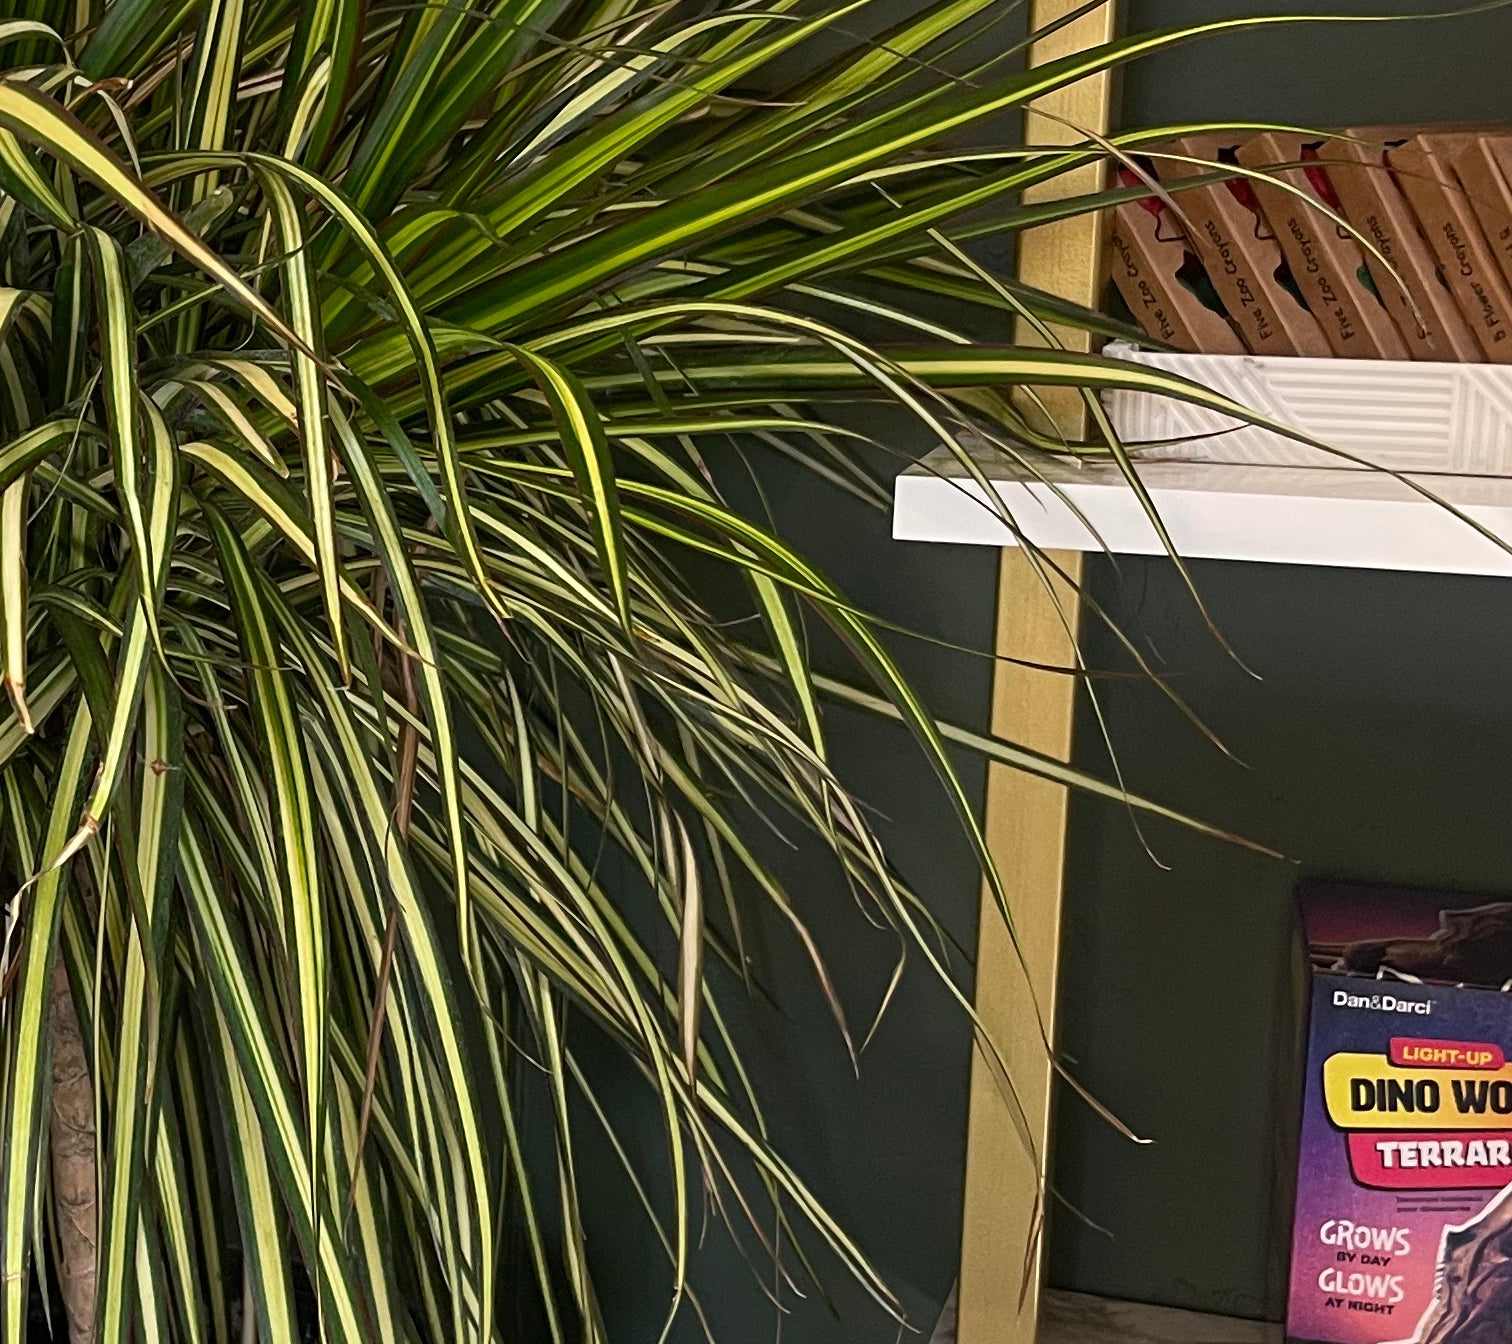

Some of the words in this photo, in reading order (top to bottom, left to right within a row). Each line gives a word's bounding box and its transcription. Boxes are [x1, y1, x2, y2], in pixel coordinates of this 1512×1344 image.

[1204, 219, 1237, 274] Crayons
[1288, 218, 1319, 273] Crayons
[1443, 222, 1473, 276] Crayons
[1138, 280, 1157, 309] Zoo
[1236, 278, 1255, 307] Zoo
[1318, 277, 1337, 306] Zoo
[1471, 282, 1500, 328] Flower
[1155, 308, 1175, 340] Five
[1252, 308, 1273, 341] Five
[1335, 308, 1356, 341] Five
[1333, 991, 1432, 1015] Dan&Darci
[1402, 1046, 1493, 1065] LIGHT-UP
[1350, 1078, 1440, 1113] DINO
[1320, 1219, 1411, 1256] GROWS
[1337, 1251, 1357, 1262] BY
[1361, 1255, 1391, 1267] DAY
[1319, 1268, 1404, 1303] GLOWS
[1325, 1298, 1345, 1308] AT
[1348, 1301, 1395, 1315] NIGHT
